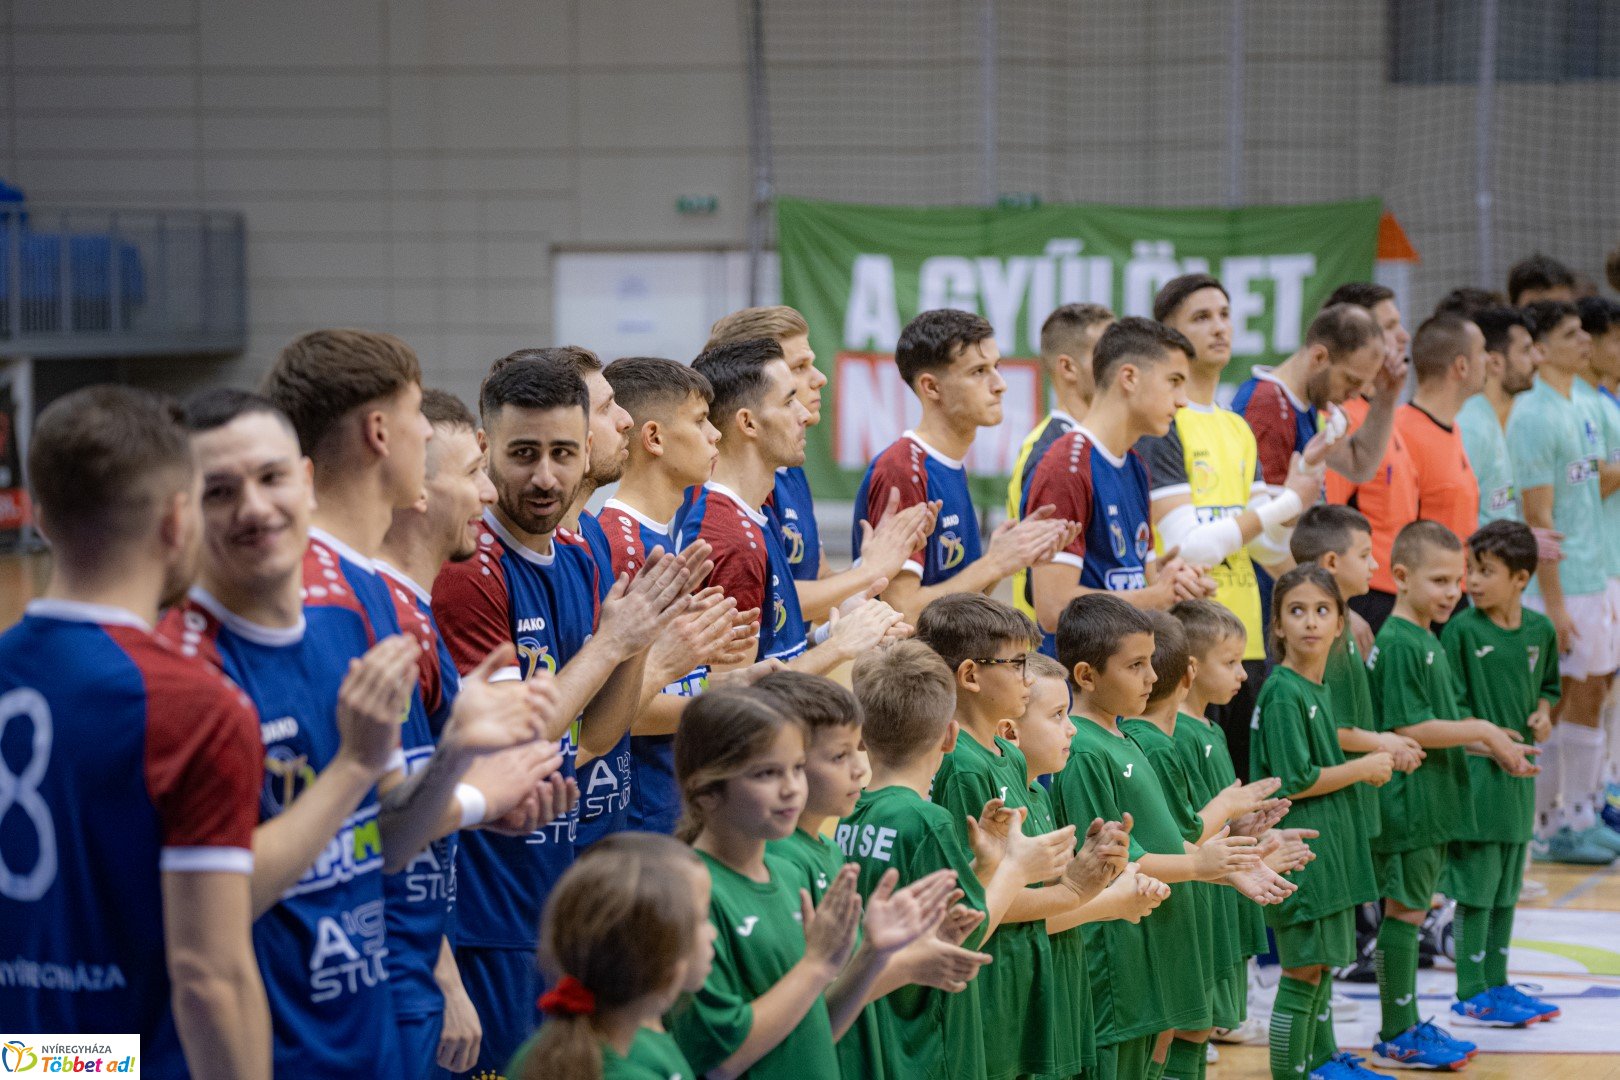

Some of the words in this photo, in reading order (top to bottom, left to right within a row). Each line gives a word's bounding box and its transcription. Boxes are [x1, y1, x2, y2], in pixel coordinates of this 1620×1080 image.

[843, 254, 897, 351] A
[918, 238, 1316, 357] GYŰÖET
[838, 360, 1037, 477] NM
[517, 617, 546, 632] JAKO
[0, 686, 58, 901] 8
[836, 823, 898, 862] RISE
